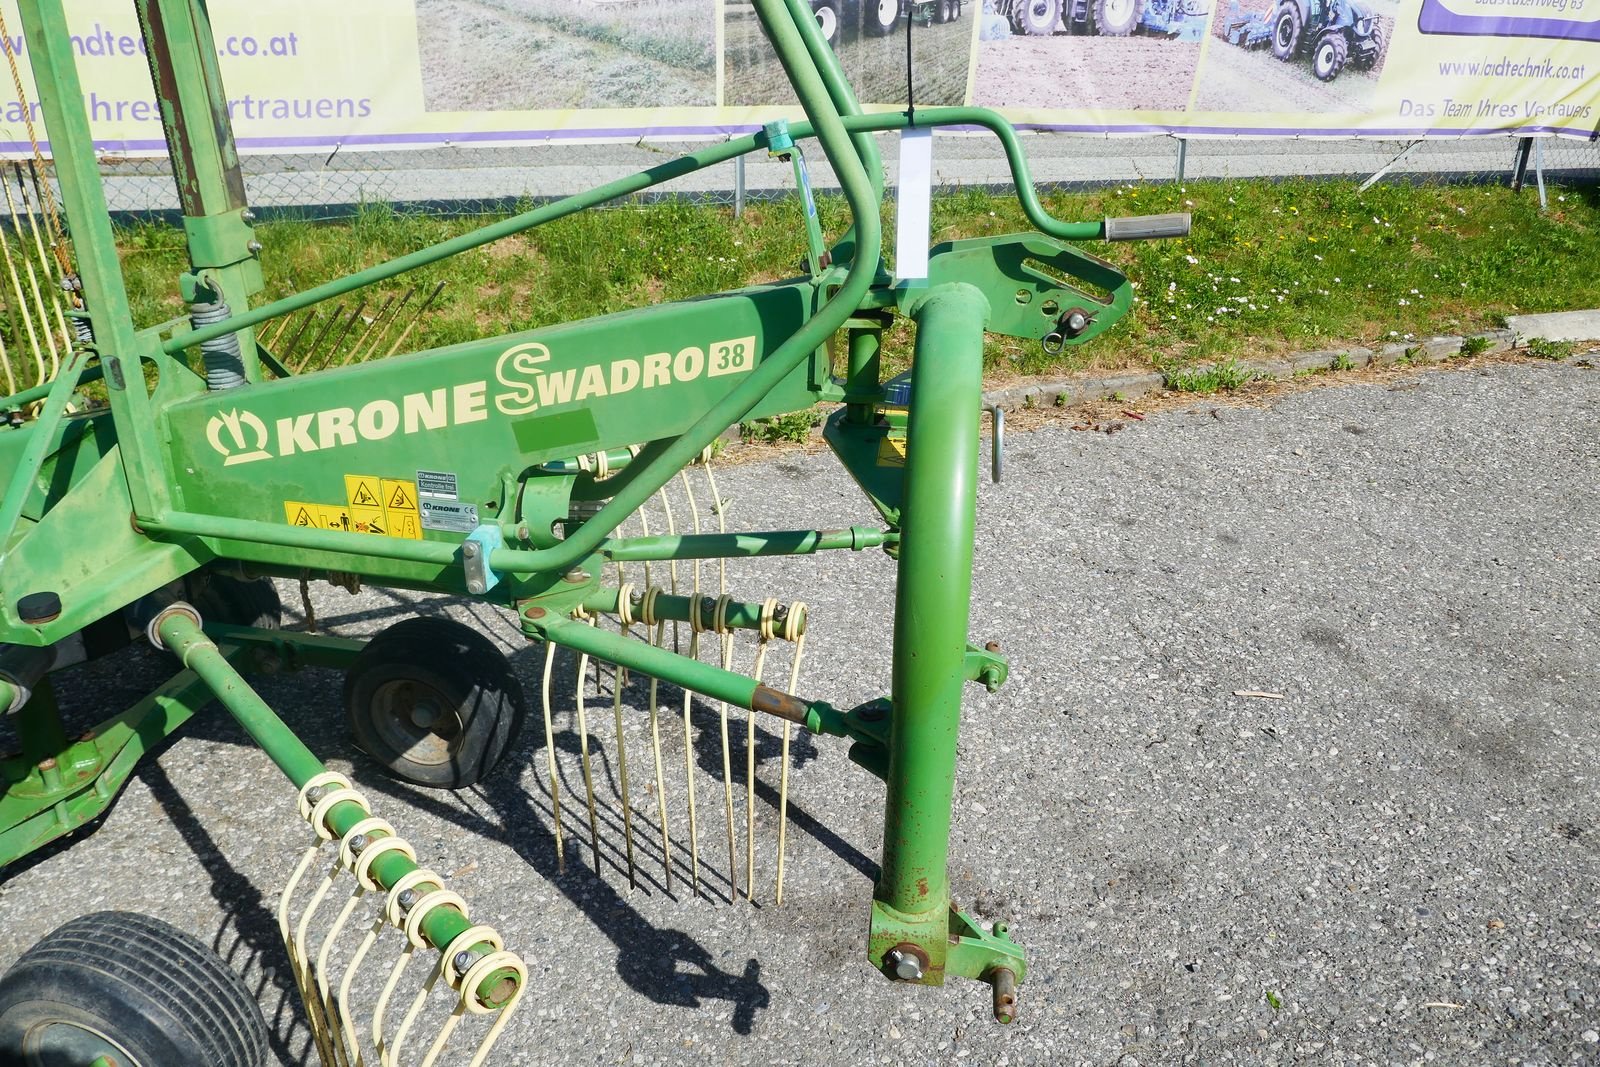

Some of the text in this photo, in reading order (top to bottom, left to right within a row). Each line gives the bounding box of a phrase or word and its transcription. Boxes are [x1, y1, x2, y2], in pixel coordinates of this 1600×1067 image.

[82, 93, 371, 122] hres rtrauens
[1399, 98, 1592, 119] Das Team Ihres Vetraues
[276, 380, 488, 457] KRONE
[717, 343, 746, 372] 38
[432, 505, 461, 513] KRONE
